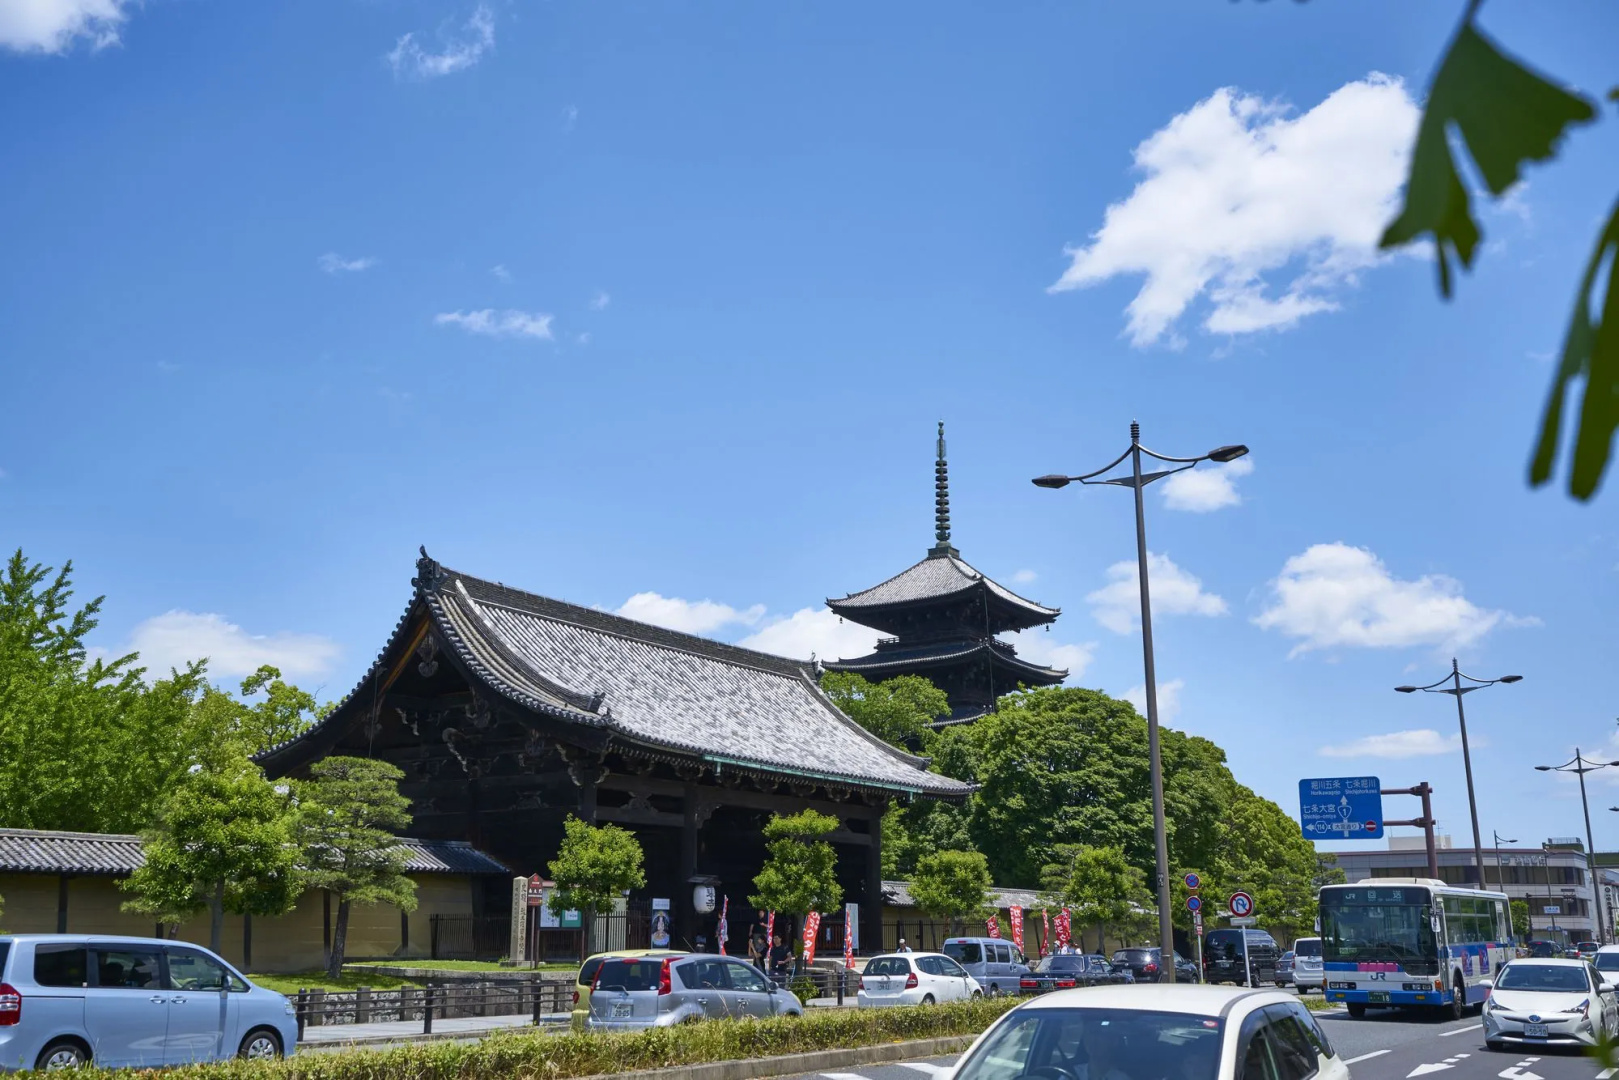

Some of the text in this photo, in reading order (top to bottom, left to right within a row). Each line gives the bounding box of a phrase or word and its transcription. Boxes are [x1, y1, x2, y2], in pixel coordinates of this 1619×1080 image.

[1303, 804, 1336, 813] 七条大宮
[1342, 808, 1347, 816] 1
[1370, 972, 1386, 981] JR
